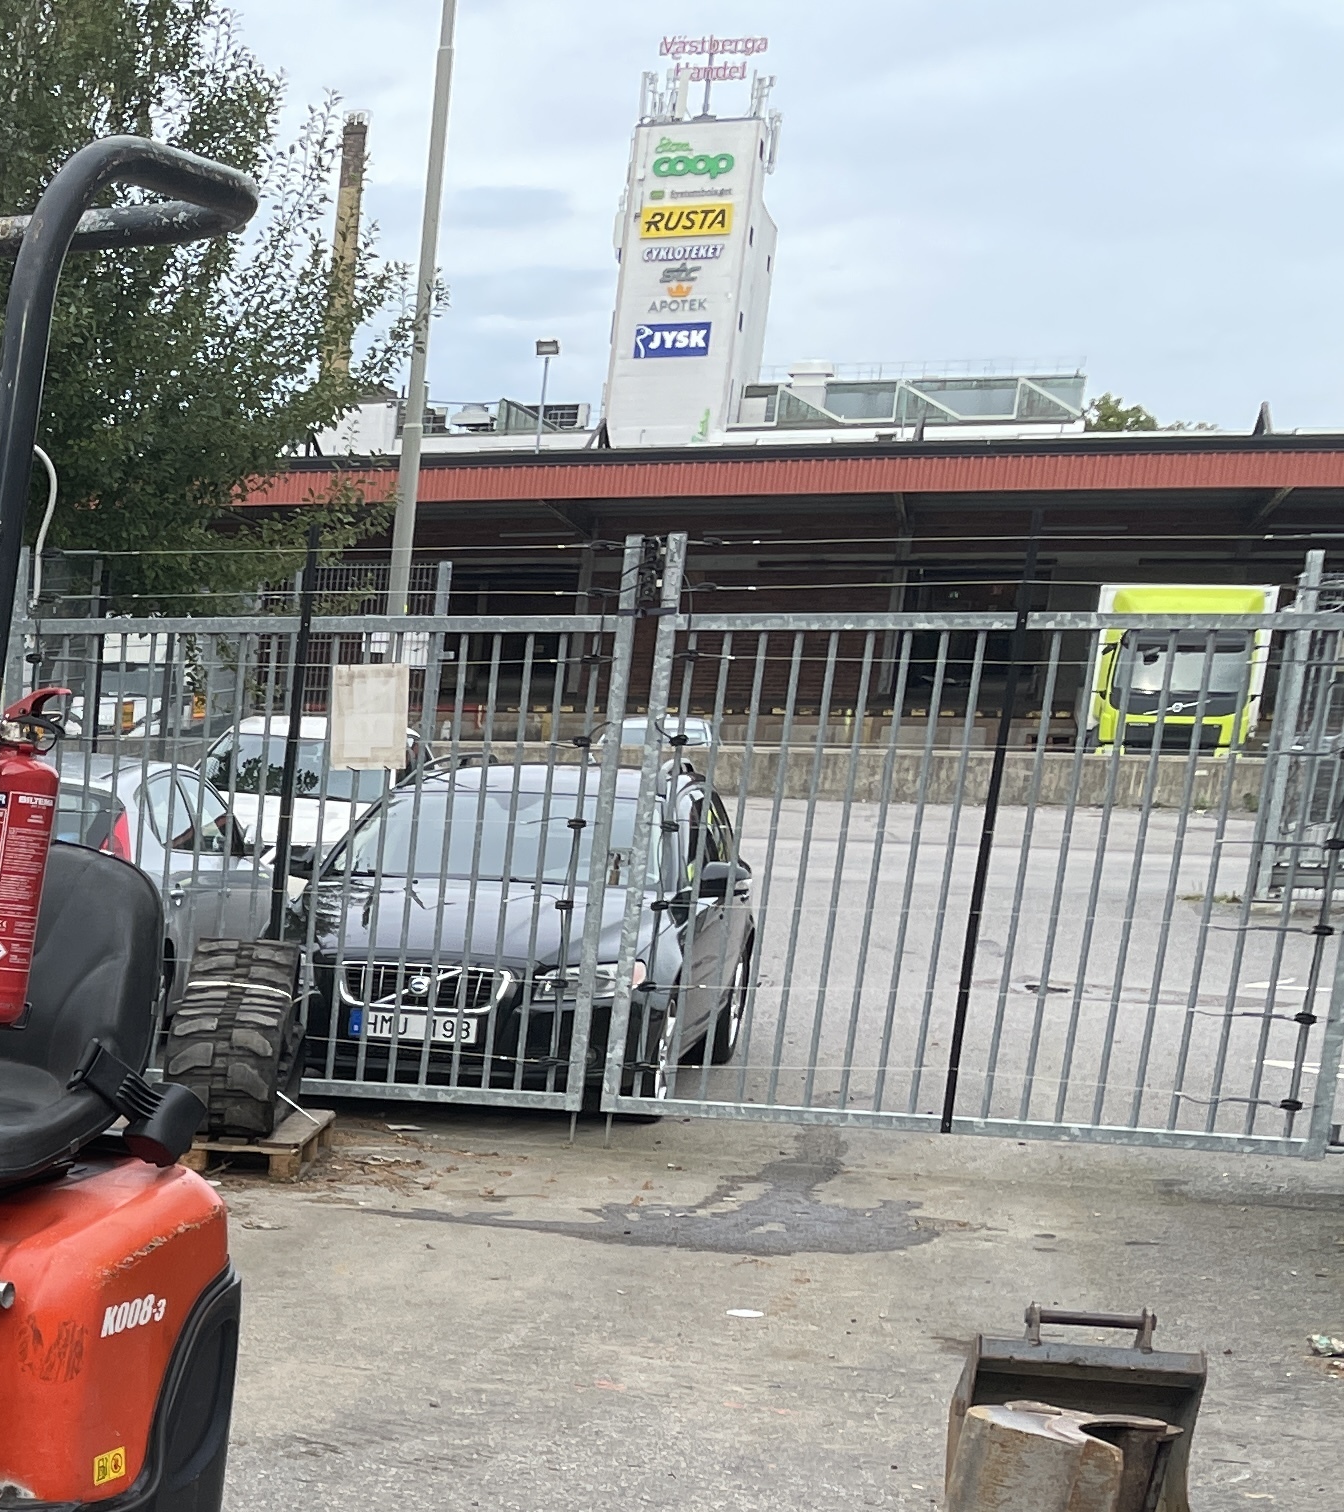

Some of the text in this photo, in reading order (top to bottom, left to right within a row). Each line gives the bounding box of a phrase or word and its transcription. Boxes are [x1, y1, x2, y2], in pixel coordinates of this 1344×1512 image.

[645, 208, 726, 232] RUSTA
[642, 244, 725, 262] CYKLOTEKET
[648, 298, 707, 313] APOTEK
[648, 329, 707, 349] JYSK
